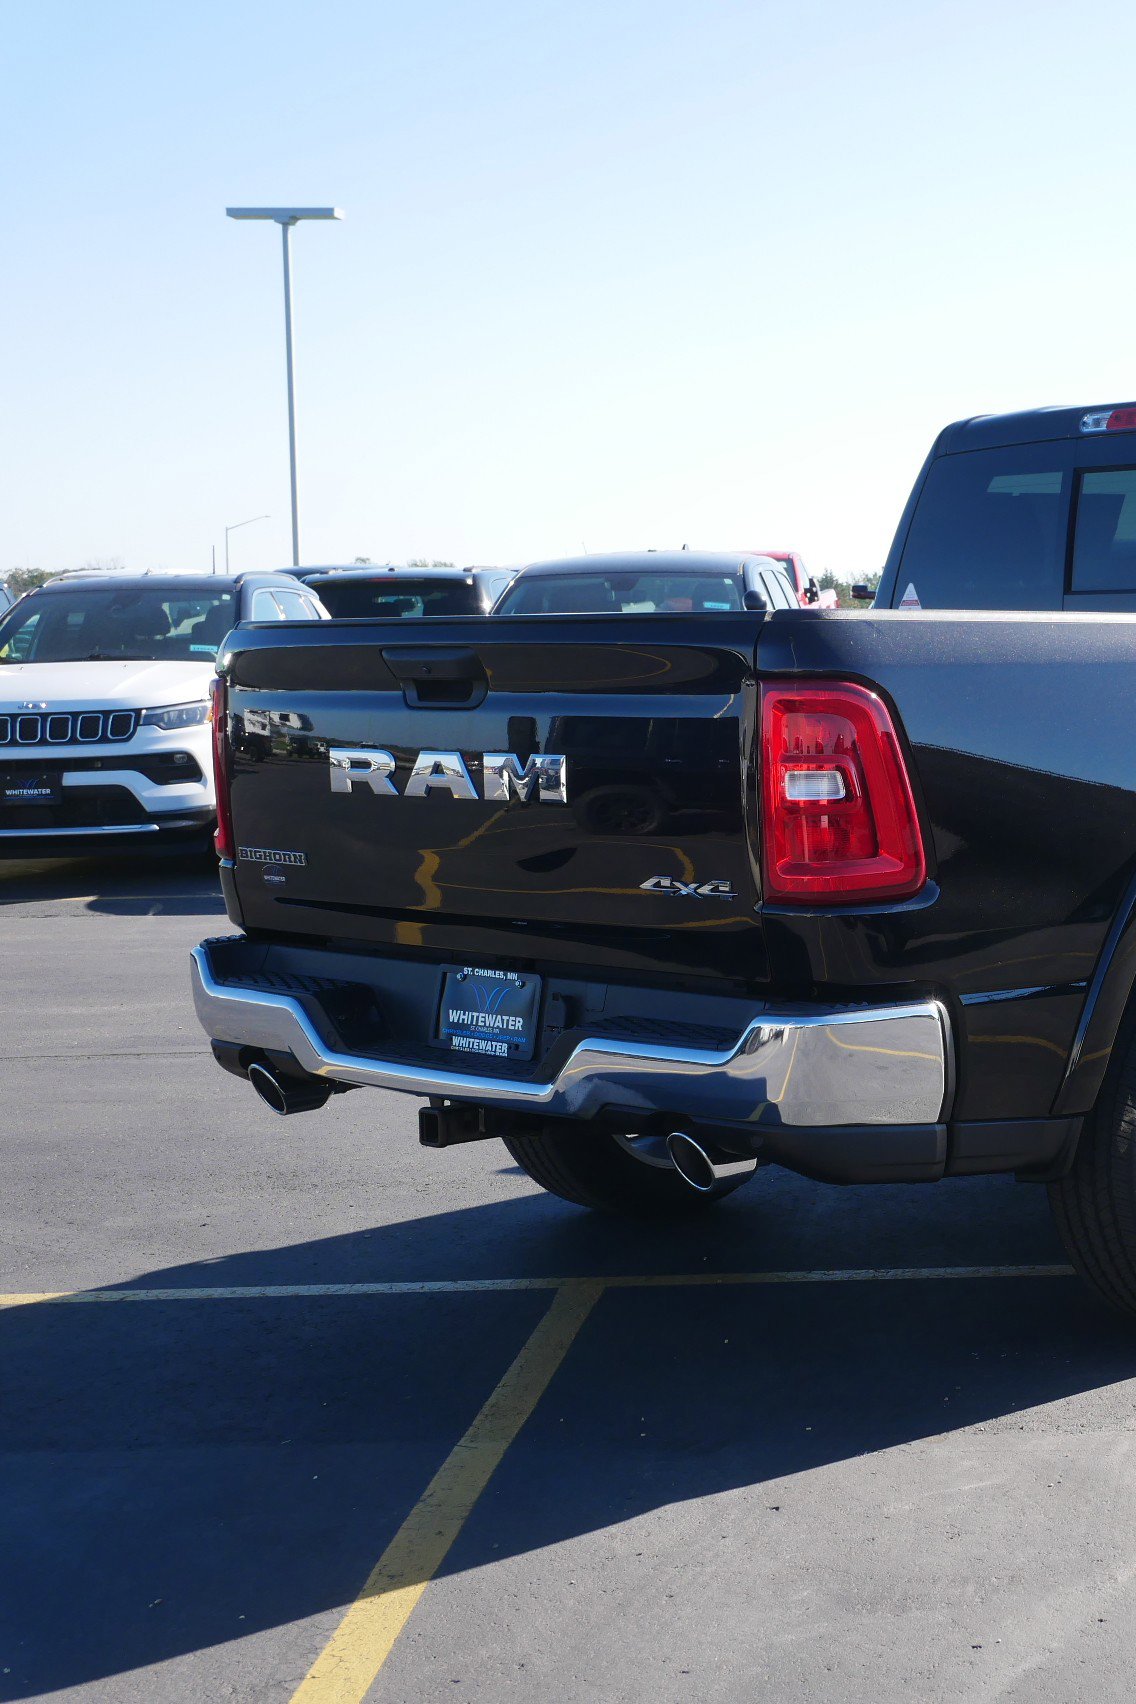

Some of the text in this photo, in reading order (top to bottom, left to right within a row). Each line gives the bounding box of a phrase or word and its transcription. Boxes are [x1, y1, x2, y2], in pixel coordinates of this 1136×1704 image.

[329, 748, 567, 804] RAM
[238, 846, 306, 866] BIGHORN
[463, 967, 518, 981] ST. CHARLES, MN
[449, 1009, 524, 1031] WHITEWATER
[452, 1036, 508, 1054] WHITEWATER
